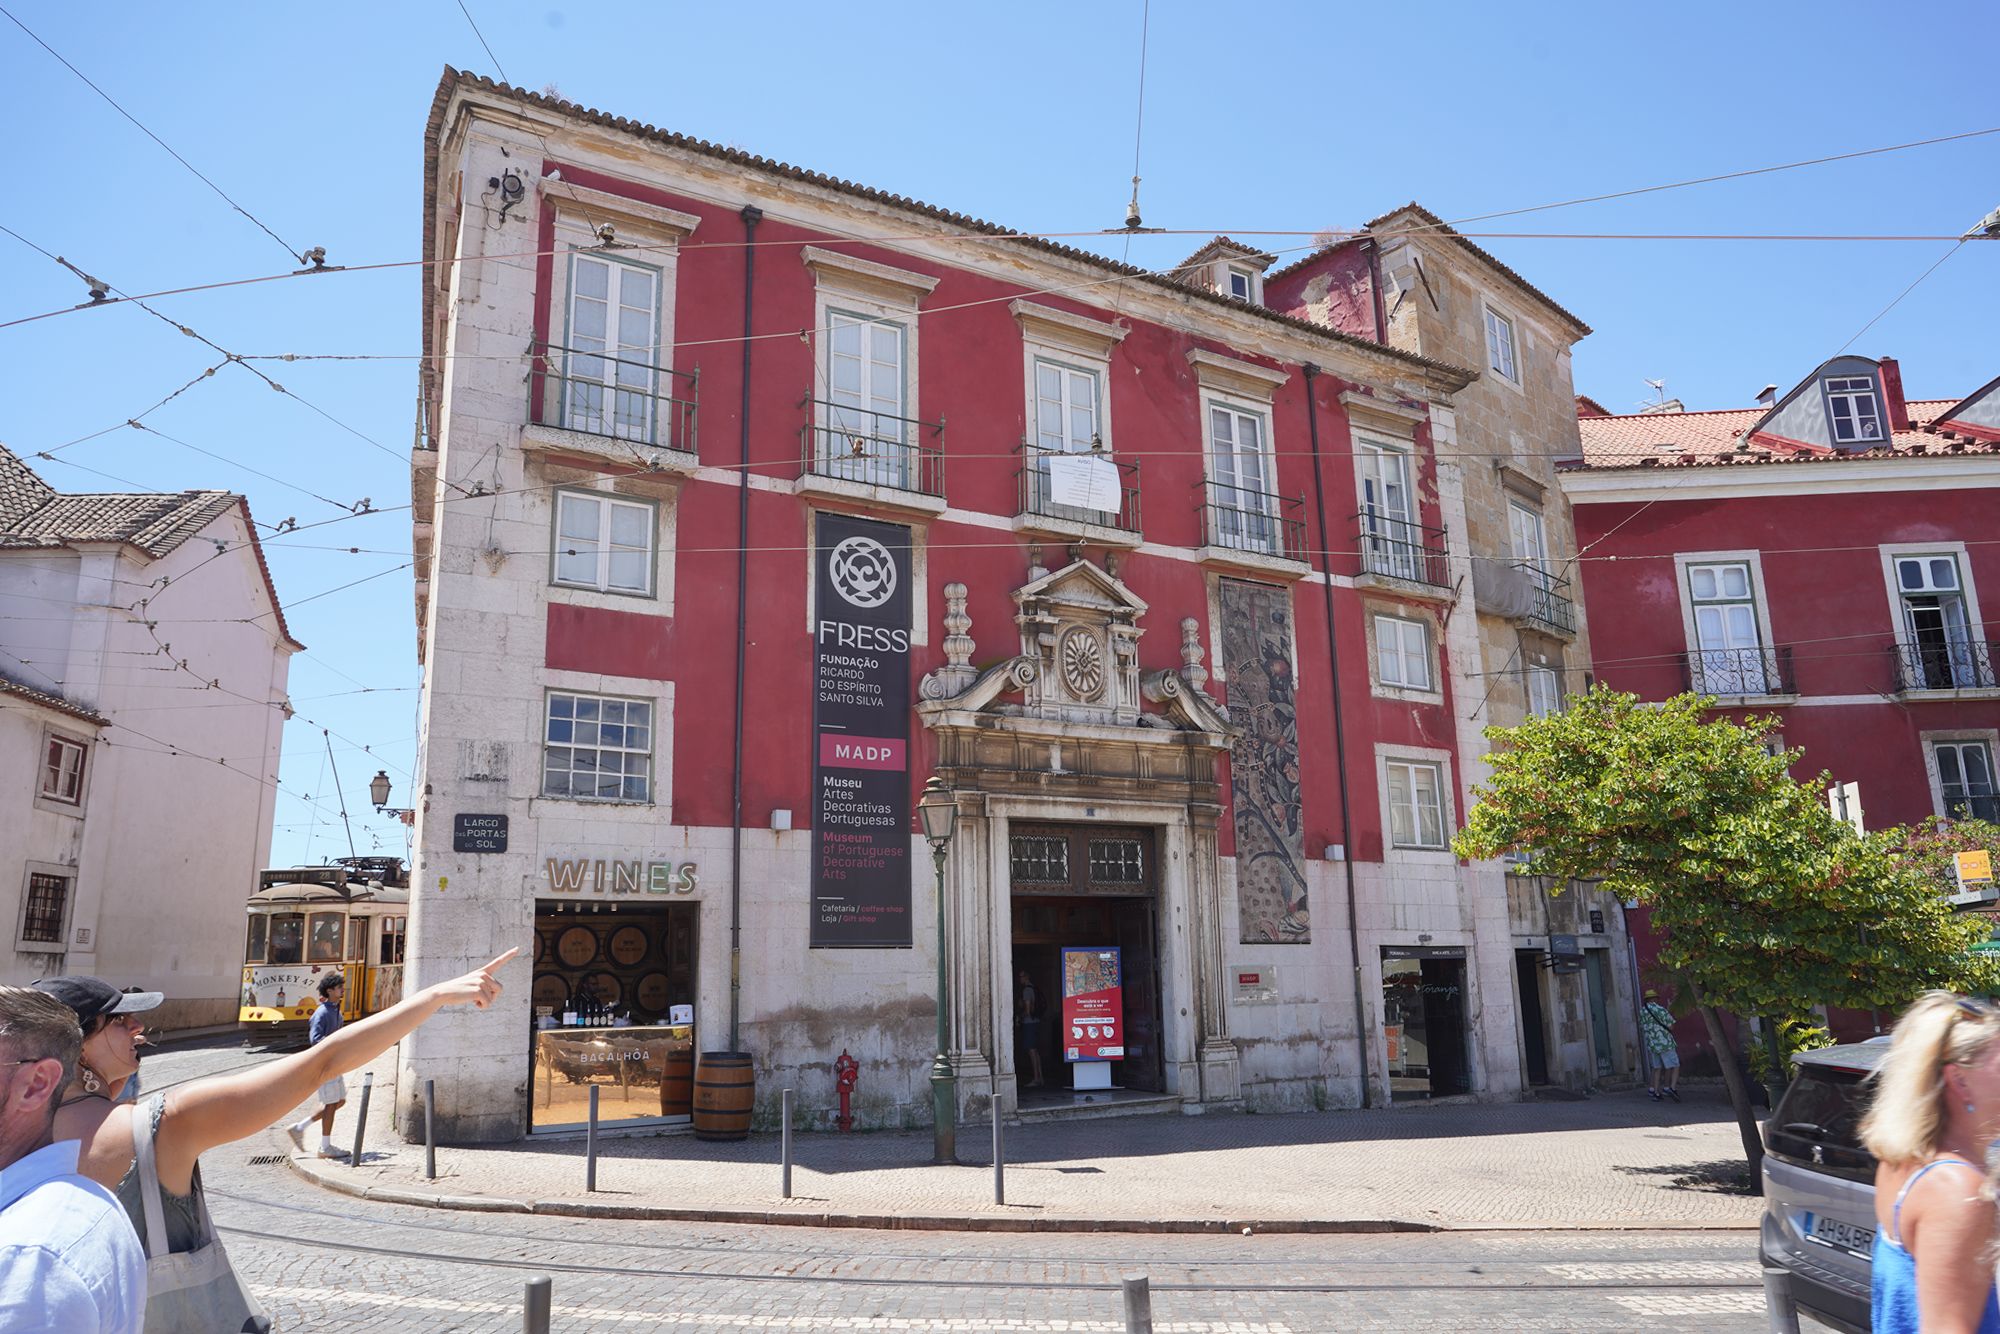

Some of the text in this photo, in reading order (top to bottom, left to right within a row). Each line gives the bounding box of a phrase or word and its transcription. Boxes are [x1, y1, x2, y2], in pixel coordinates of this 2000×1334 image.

[820, 620, 908, 653] FRESS
[820, 654, 879, 669] FUNDAÇÃO
[820, 666, 865, 680] RICARDO
[820, 680, 881, 694] DO ESPÍRITO
[820, 692, 884, 707] SANTO SILVA
[835, 744, 892, 761] MADP
[823, 776, 863, 788] Museu
[823, 788, 854, 800] Artes
[823, 800, 892, 814] Decorativas
[464, 818, 499, 827] LARGO
[823, 812, 896, 827] Portuguesas
[467, 829, 507, 839] PORTAS
[823, 831, 873, 843] Museum
[476, 839, 497, 848] SOL
[823, 844, 904, 857] of Portuguese
[823, 855, 885, 868] Decorative
[546, 858, 697, 895] WINES
[823, 868, 847, 880] Arts
[821, 904, 856, 913] Cafetaria
[861, 904, 885, 913] coffee
[886, 905, 905, 914] shop
[821, 914, 837, 924] Loja
[858, 914, 877, 924] shop
[256, 974, 301, 987] MONKEY
[302, 978, 315, 986] 47
[580, 1047, 650, 1063] BACALHÔA
